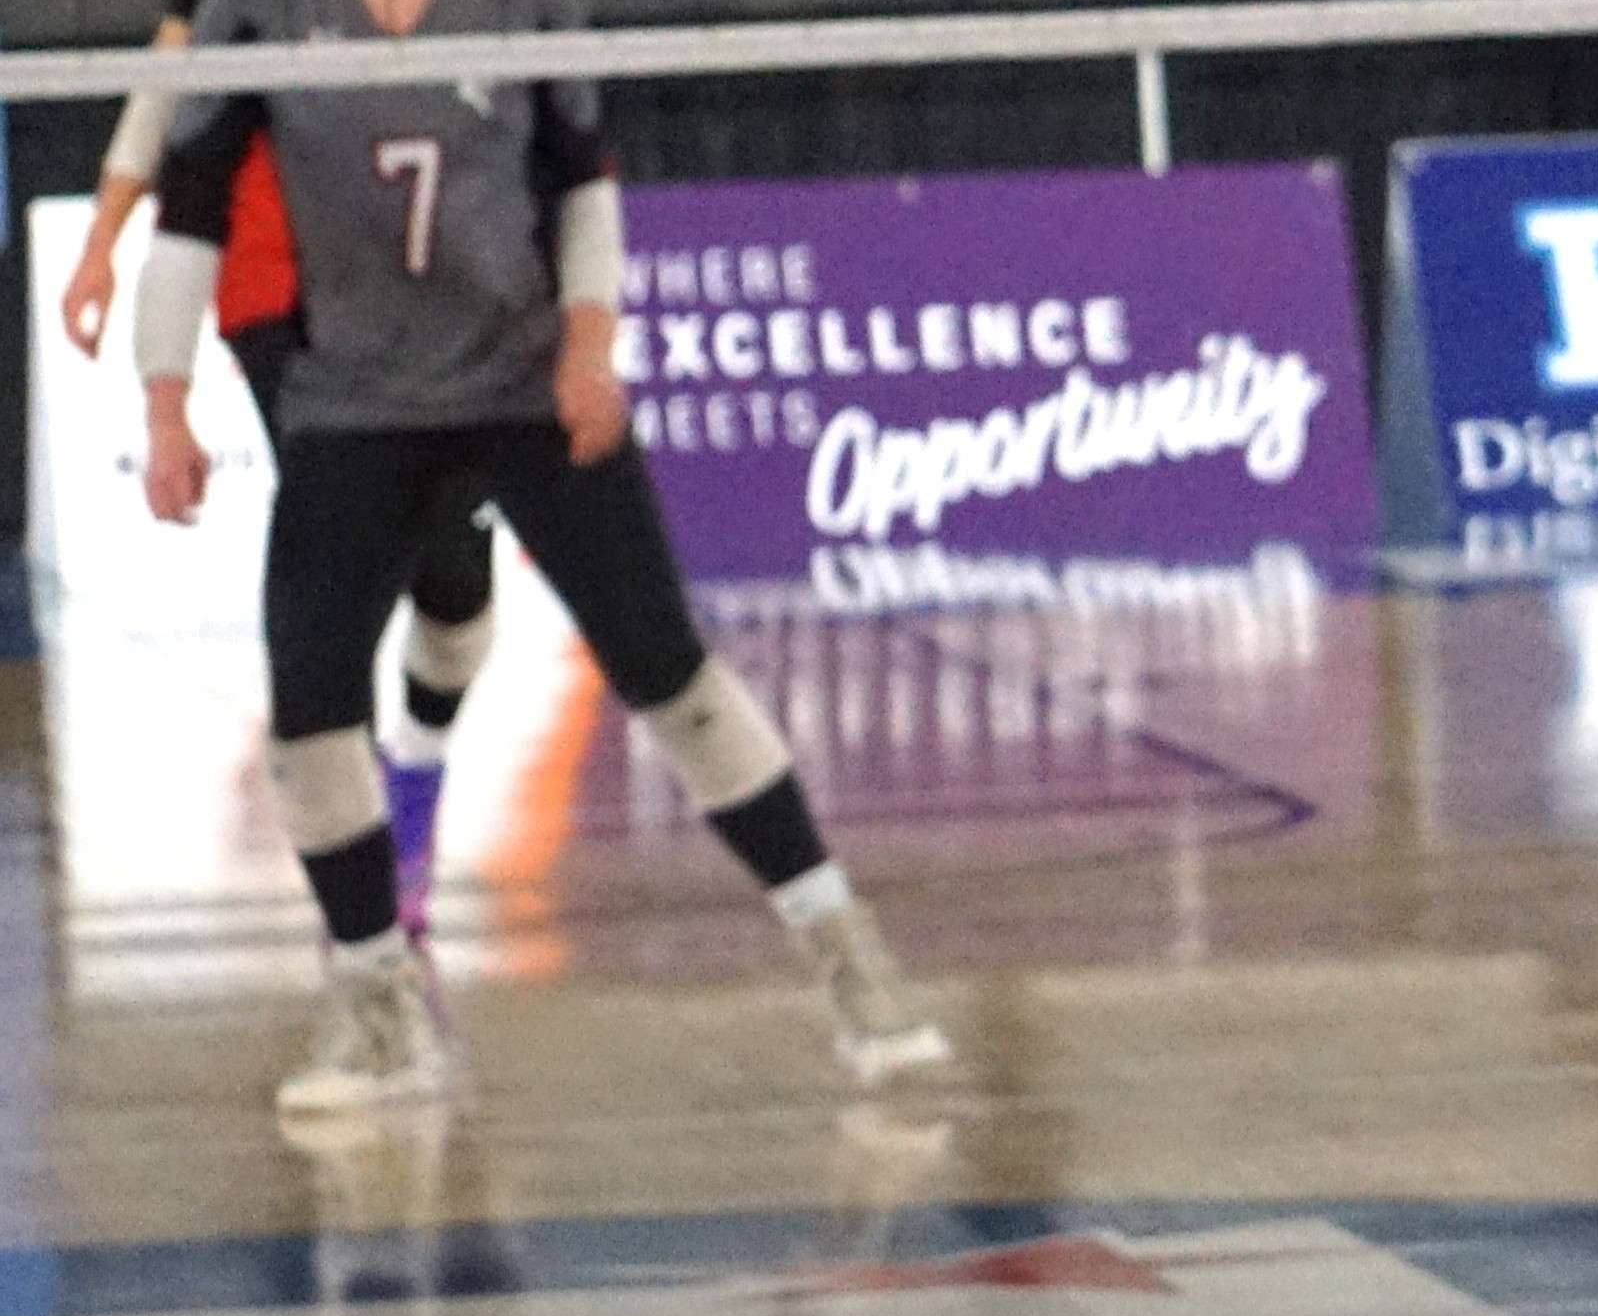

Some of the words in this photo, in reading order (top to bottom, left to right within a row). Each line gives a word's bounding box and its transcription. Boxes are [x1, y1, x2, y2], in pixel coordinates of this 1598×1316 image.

[376, 134, 443, 276] 7
[612, 296, 1131, 383] EXCELLENCE
[806, 334, 1326, 539] Opportunity
